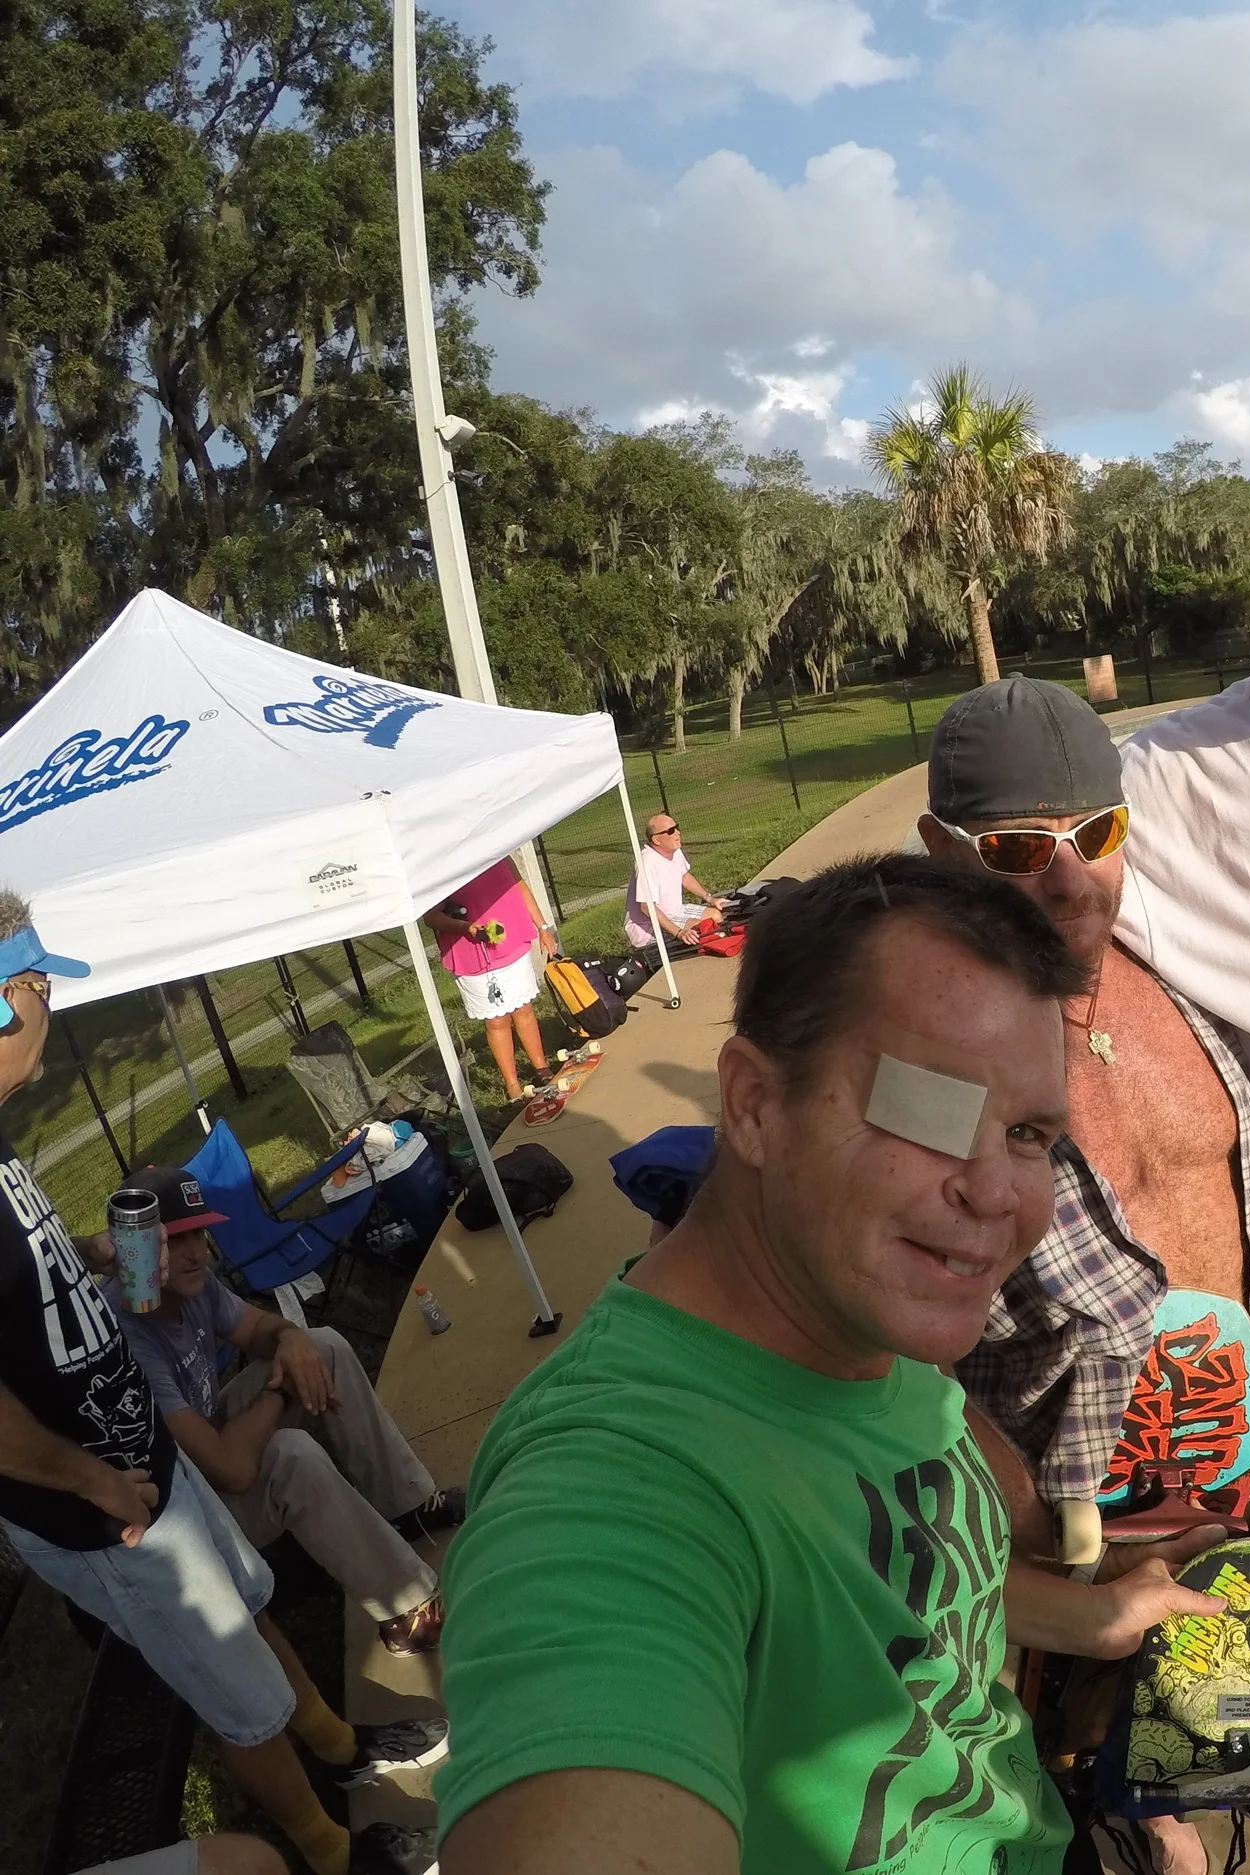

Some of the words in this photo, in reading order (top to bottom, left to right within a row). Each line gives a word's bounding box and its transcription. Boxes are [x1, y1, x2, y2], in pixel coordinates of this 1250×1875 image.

[0, 713, 190, 818] rinela
[318, 878, 353, 890] GLOBAL
[320, 882, 354, 895] CUSTOM
